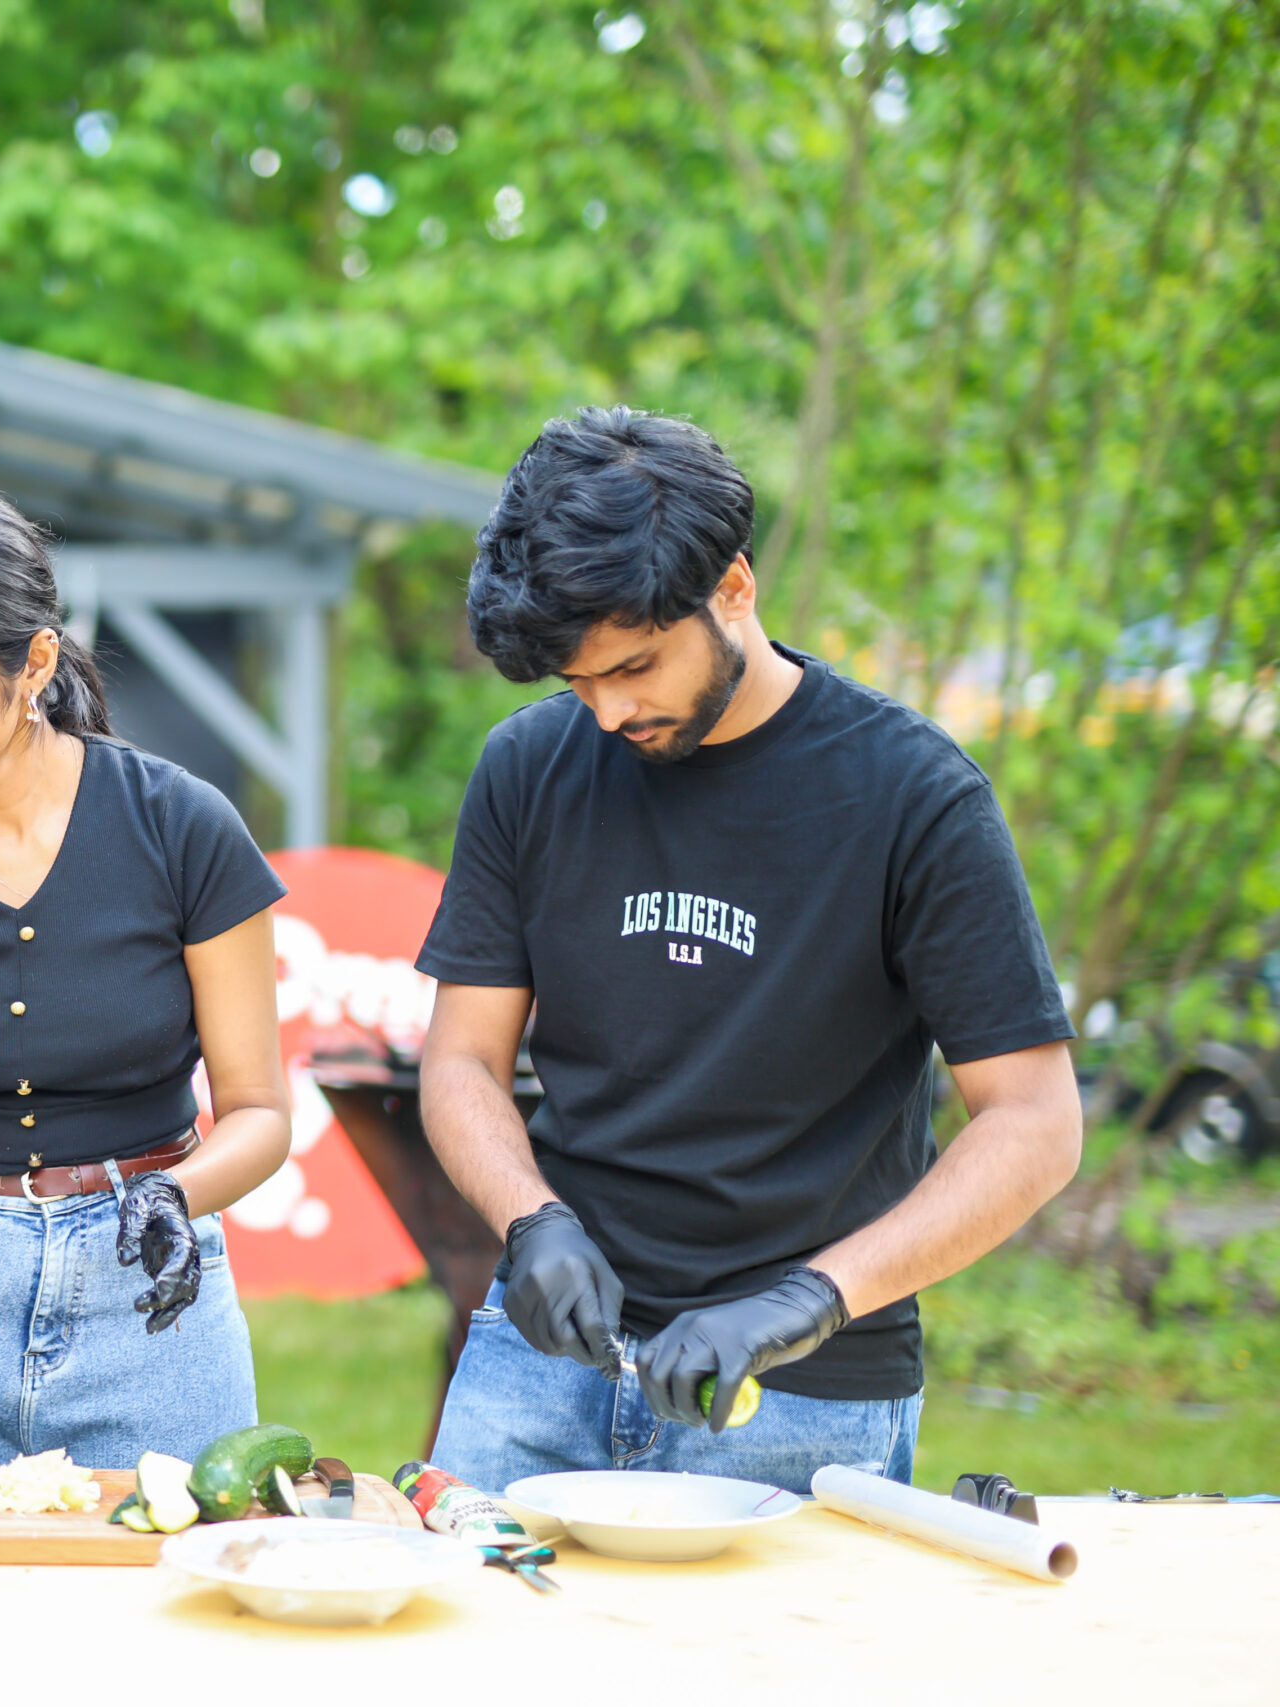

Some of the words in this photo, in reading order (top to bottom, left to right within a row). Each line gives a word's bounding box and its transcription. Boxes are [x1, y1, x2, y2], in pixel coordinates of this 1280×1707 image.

[621, 891, 662, 936] LOS
[664, 891, 757, 956] ANGELES
[668, 942, 703, 965] U.S.A
